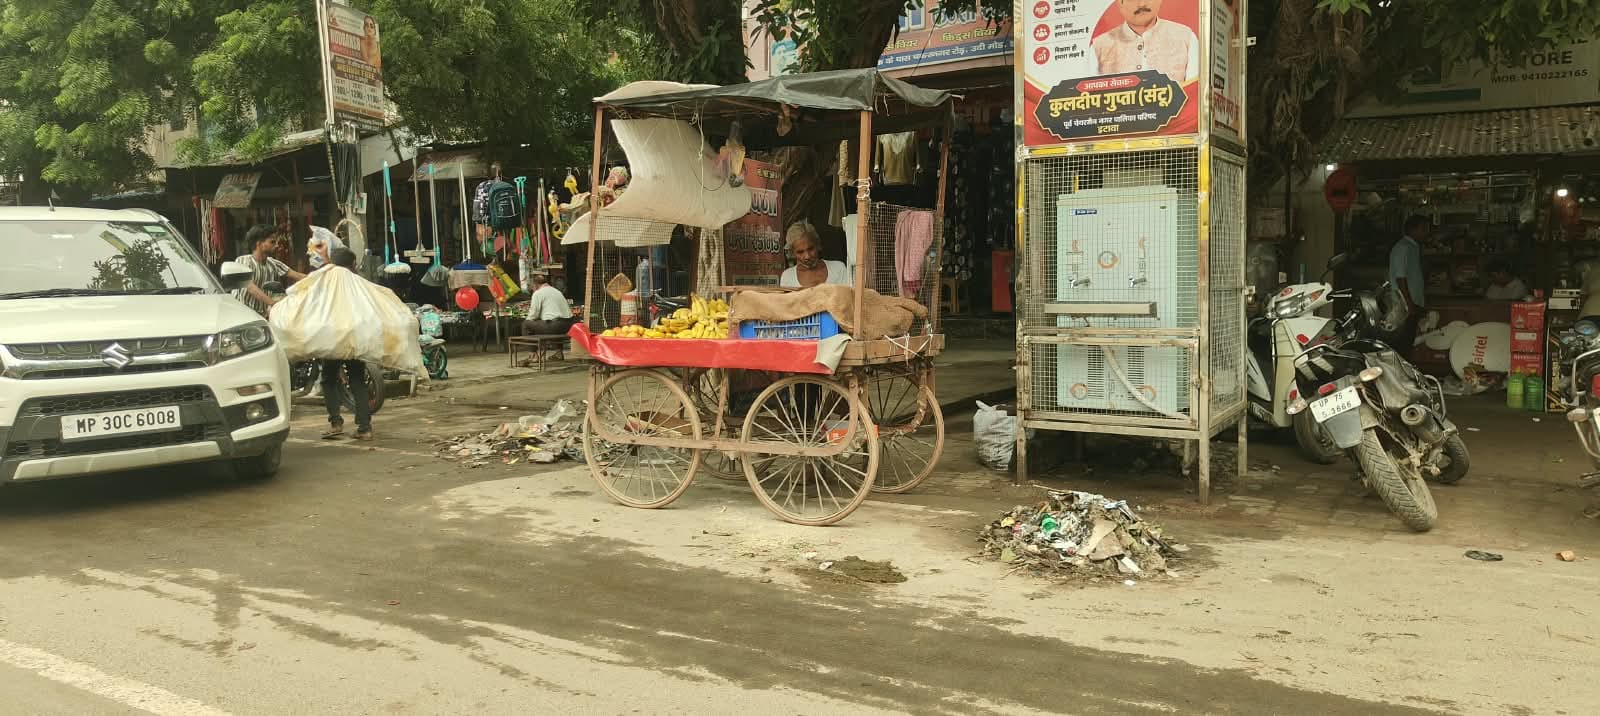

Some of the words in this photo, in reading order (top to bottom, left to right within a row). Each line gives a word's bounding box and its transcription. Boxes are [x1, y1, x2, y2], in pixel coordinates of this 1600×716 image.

[1521, 69, 1588, 80] 9410222165
[1084, 82, 1108, 90] आपका
[1049, 91, 1101, 117] कुलदीप
[1103, 90, 1137, 111] गुप्ता
[1138, 84, 1173, 107] (संटू)
[1097, 124, 1119, 134] इटावा
[1473, 335, 1489, 366] airtel
[1318, 398, 1329, 408] UP
[1334, 392, 1343, 402] 75
[76, 418, 97, 433] MP
[102, 414, 132, 430] 30C
[136, 410, 176, 427] 6008
